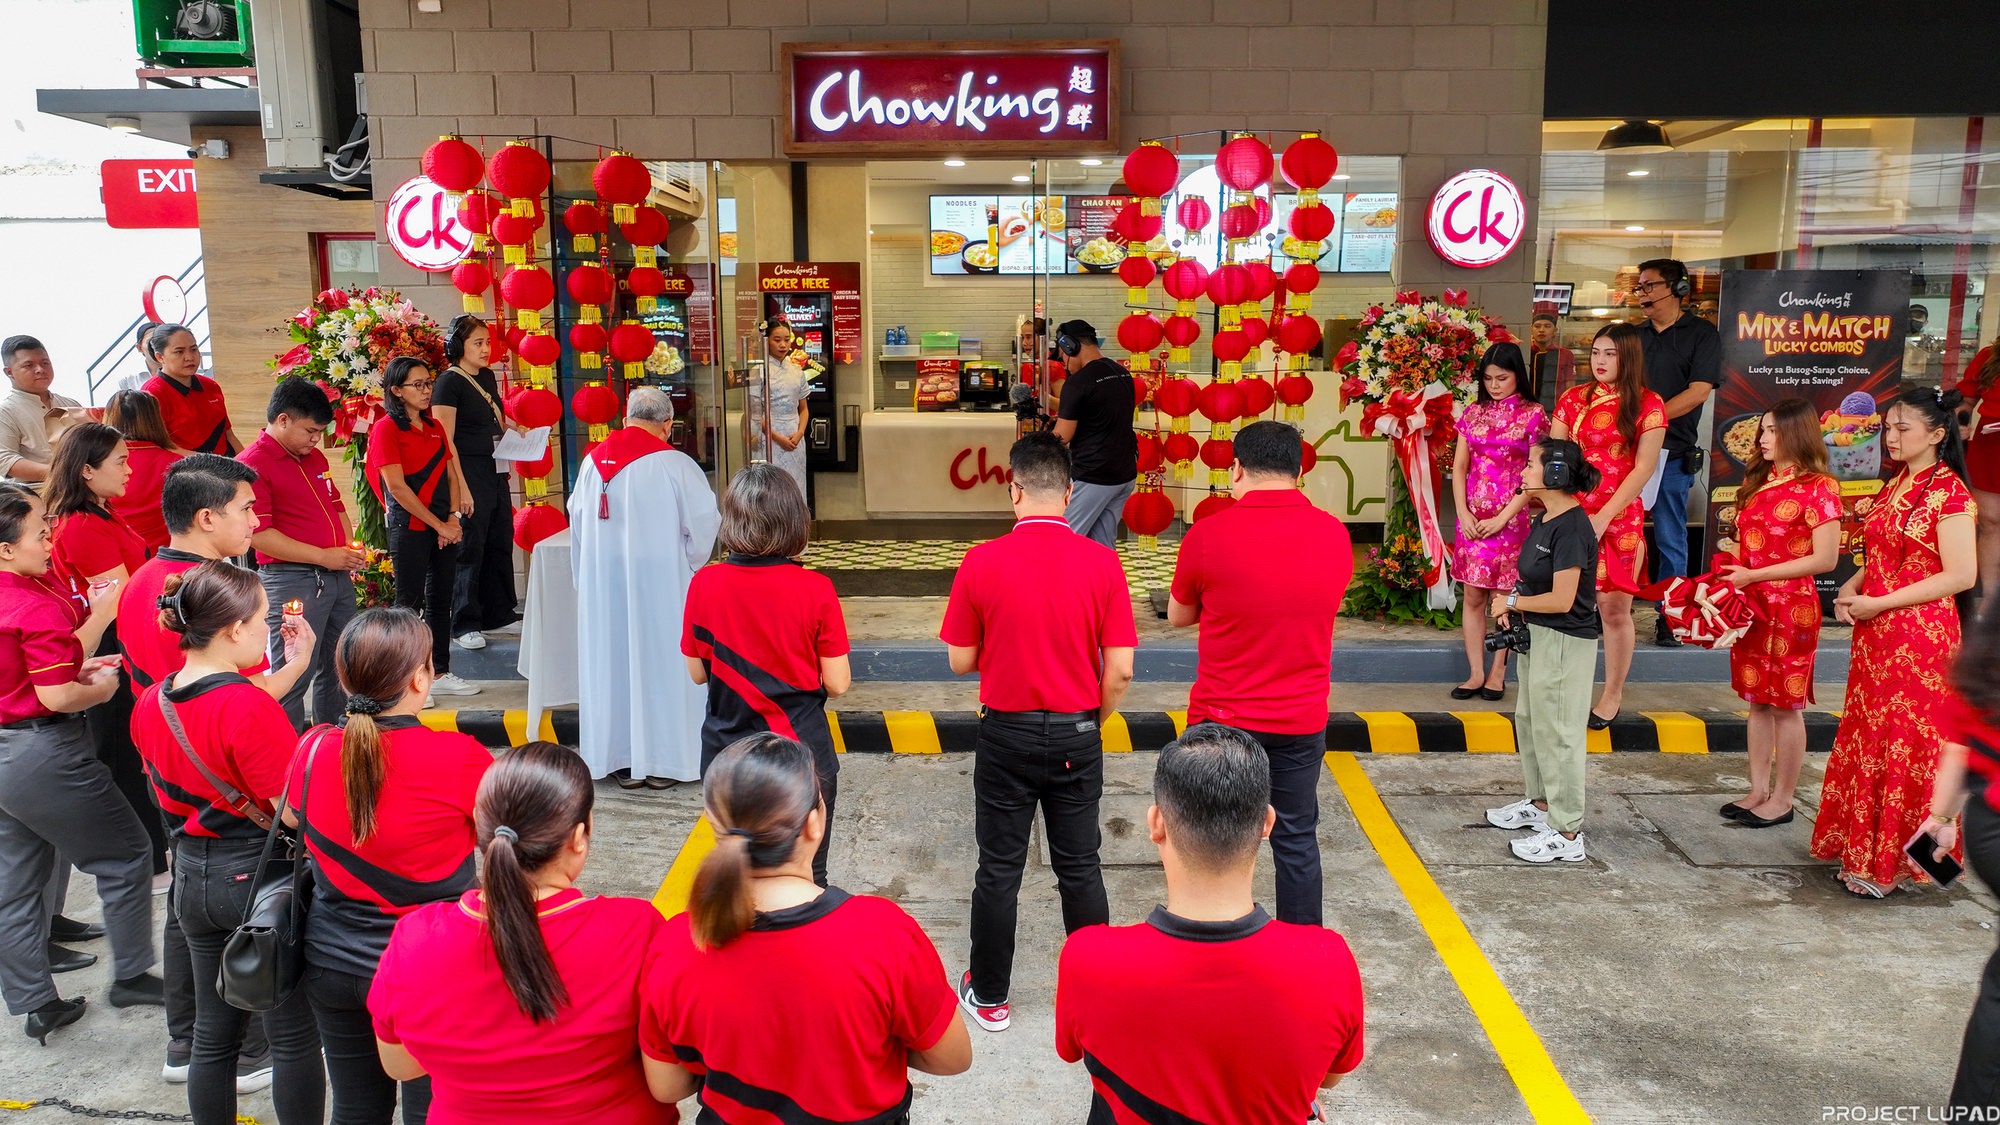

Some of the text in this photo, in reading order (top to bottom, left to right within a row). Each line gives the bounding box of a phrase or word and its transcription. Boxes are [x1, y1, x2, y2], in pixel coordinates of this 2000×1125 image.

[809, 69, 1059, 132] Chowking
[138, 168, 198, 193] EXIT
[1081, 199, 1123, 207] CHAO FAN
[398, 191, 468, 252] Ck
[443, 185, 511, 247] Ck
[774, 264, 813, 276] Chowking
[665, 278, 686, 290] ERE
[762, 277, 830, 289] ORDER HERE
[1779, 291, 1842, 309] Chowking
[786, 313, 813, 321] DELIVERY
[1738, 312, 1891, 340] MIX & MATCH
[1764, 339, 1864, 355] LUCKY COMBOS
[1748, 365, 1773, 376] Lucky
[1785, 365, 1836, 376] Busog-Sarap
[1837, 365, 1871, 376] Choices,
[1775, 376, 1800, 387] Lucky
[1811, 376, 1844, 387] Savings!
